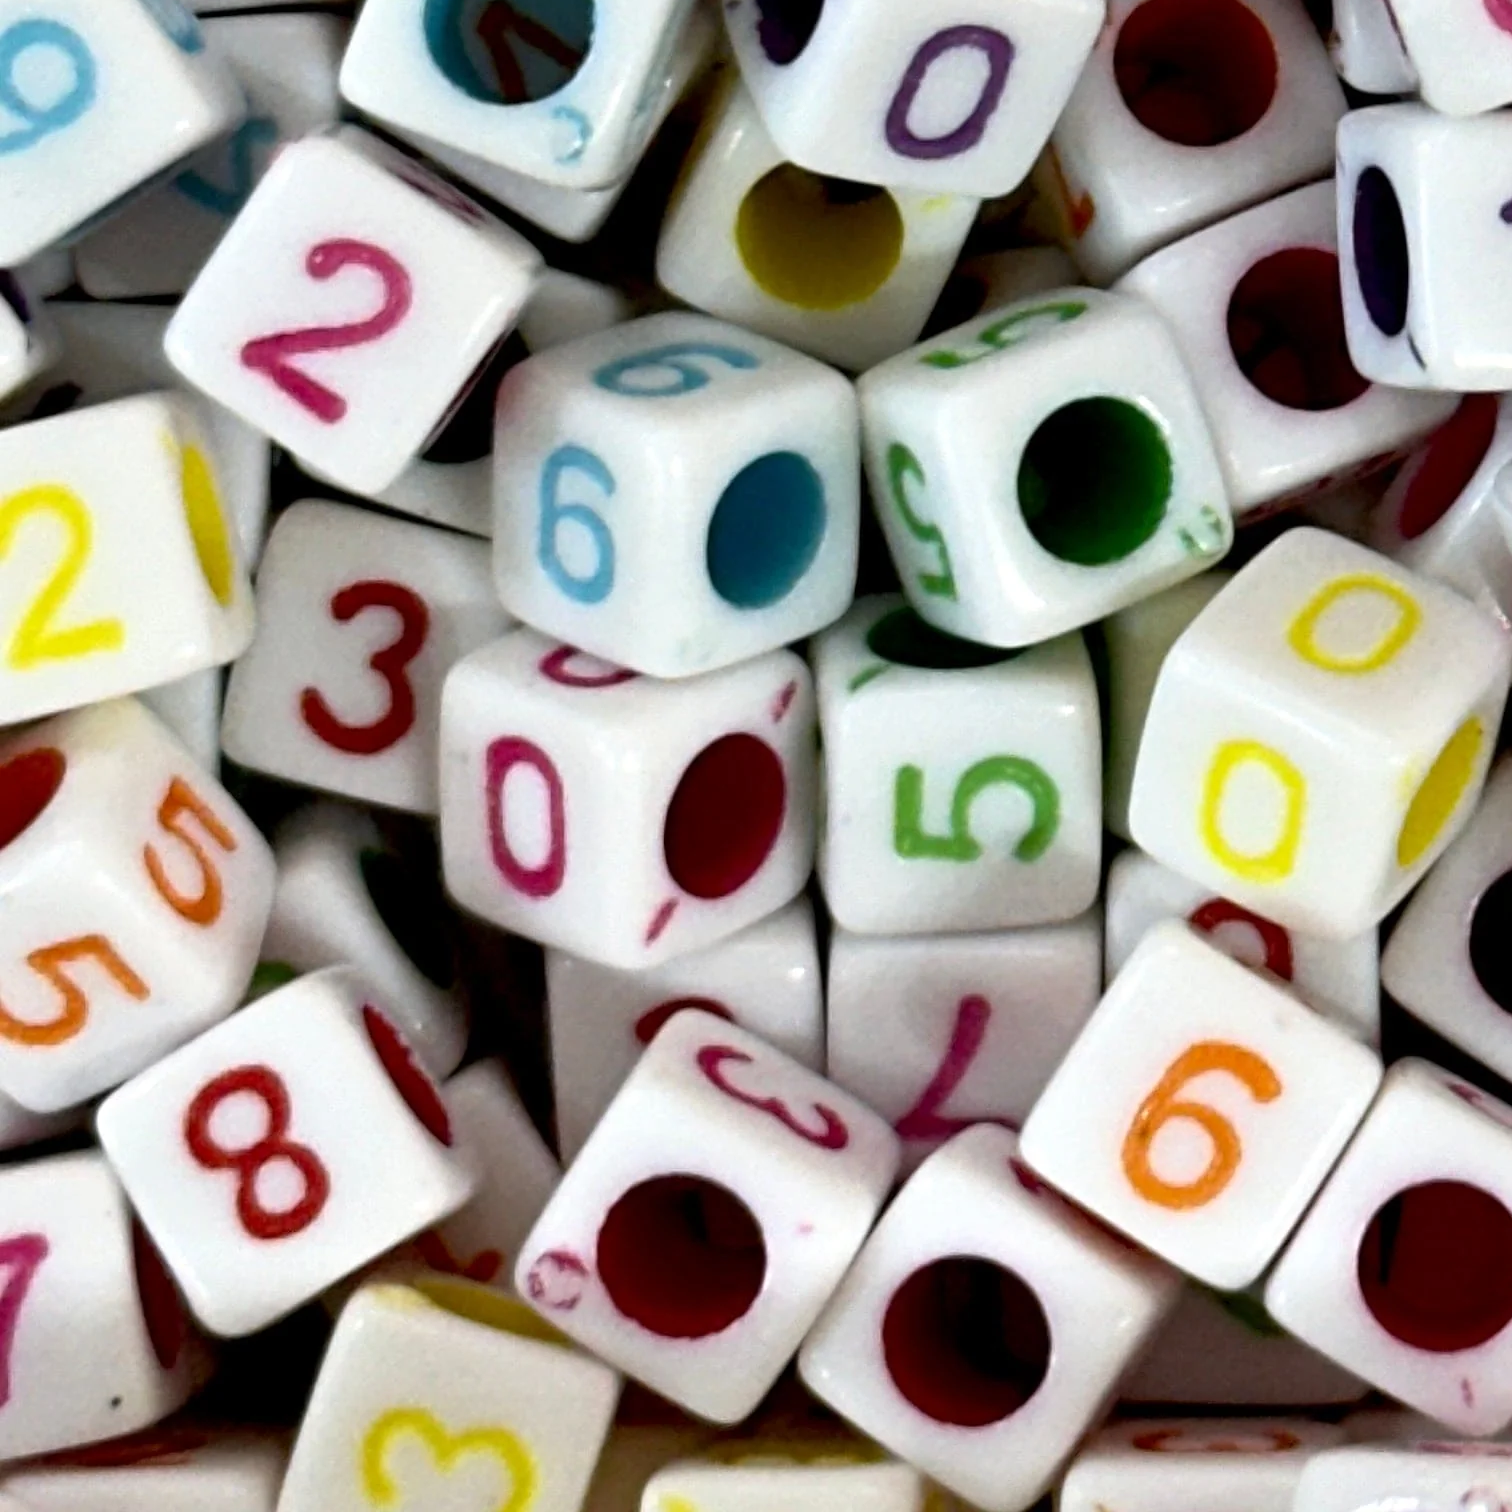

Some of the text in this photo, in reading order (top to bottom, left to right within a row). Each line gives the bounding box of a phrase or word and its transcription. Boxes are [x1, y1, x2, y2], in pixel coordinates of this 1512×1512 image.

[889, 28, 1009, 152] 0
[243, 241, 409, 421] 2
[0, 482, 126, 670] 2
[889, 446, 957, 598] 5
[303, 583, 426, 753] 3
[1286, 574, 1422, 677] 0
[146, 779, 232, 925] 5
[487, 739, 563, 897] 0
[894, 757, 1058, 861] 5
[1197, 738, 1307, 886] 0
[2, 937, 146, 1045] 5
[185, 1068, 326, 1239] 8
[697, 1045, 850, 1150] 3
[1123, 1041, 1281, 1210] 6
[362, 1410, 537, 1512] 3
